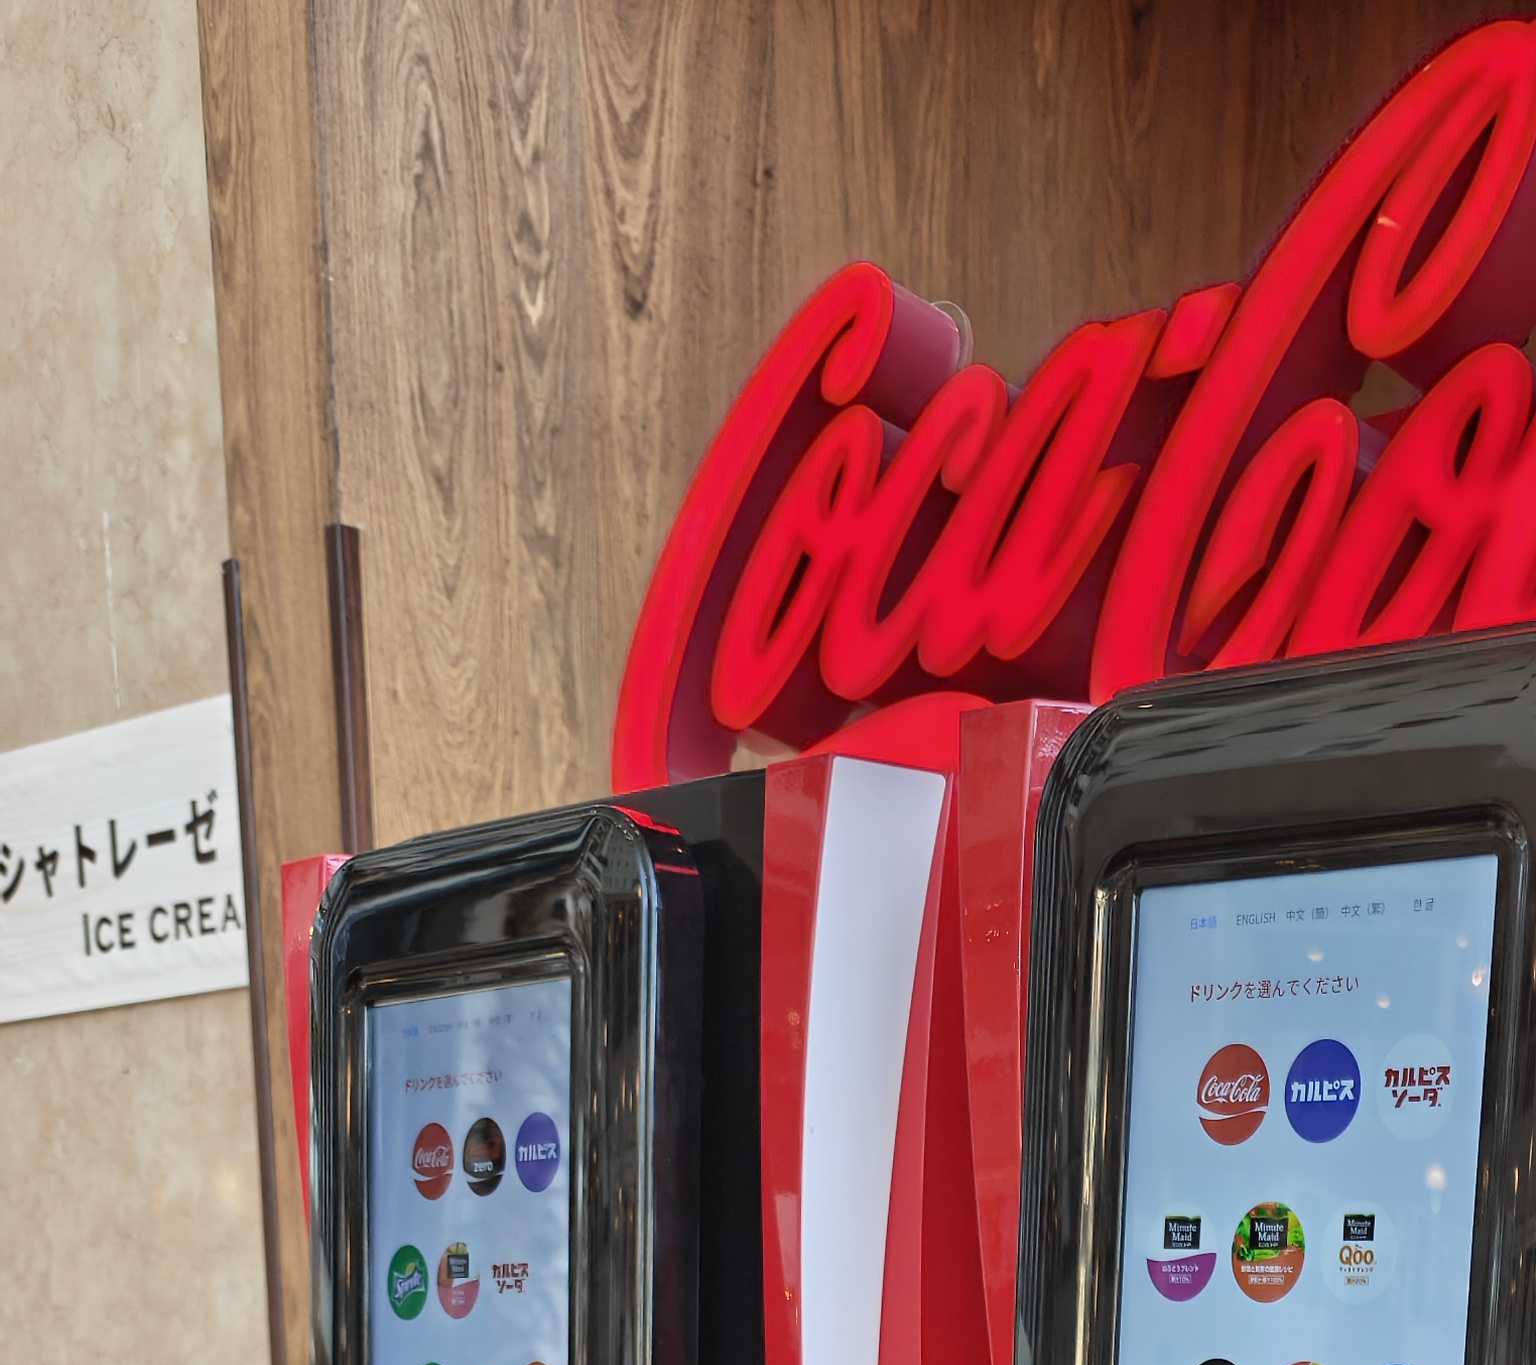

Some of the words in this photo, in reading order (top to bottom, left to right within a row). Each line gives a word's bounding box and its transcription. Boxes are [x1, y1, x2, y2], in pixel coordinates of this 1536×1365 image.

[0, 788, 219, 906] シャトレーゼ
[1236, 912, 1276, 926] ENGLISH
[83, 911, 136, 956] ICE
[1190, 975, 1359, 1003] ドリンクを選んでください
[1201, 1073, 1265, 1104] Coca-Cola
[1384, 1065, 1451, 1088] カルピス
[1291, 1079, 1355, 1103] カルピス
[1391, 1086, 1443, 1109] ソーダ
[1339, 1244, 1374, 1265] Qoo
